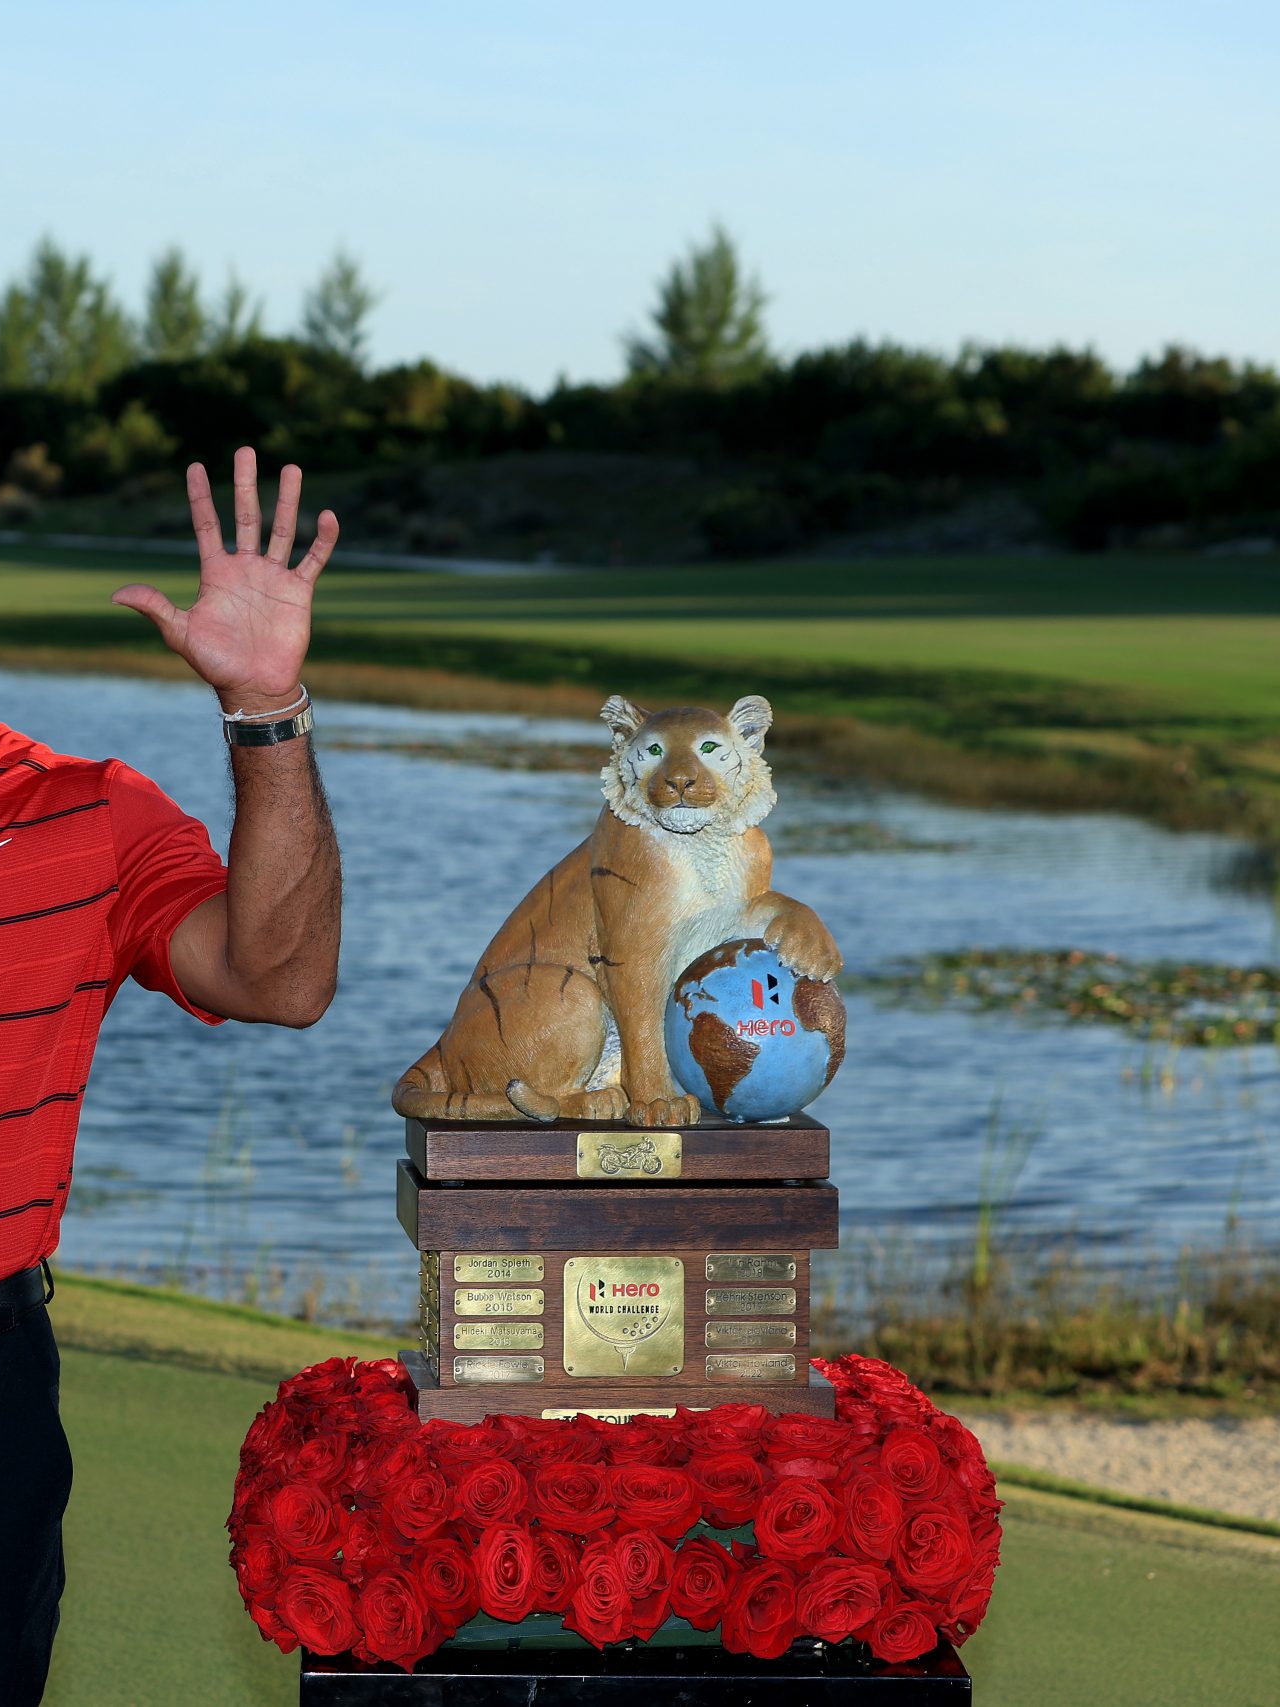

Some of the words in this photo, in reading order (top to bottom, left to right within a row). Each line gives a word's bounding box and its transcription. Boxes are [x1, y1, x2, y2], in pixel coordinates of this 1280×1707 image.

[736, 1018, 796, 1036] Hero
[468, 1258, 498, 1267] Jordan
[501, 1258, 531, 1267] Spieth
[487, 1269, 511, 1278] 2014
[612, 1283, 660, 1297] Hero
[467, 1292, 494, 1301] Bubba
[497, 1292, 532, 1301] Watson
[748, 1292, 787, 1301] Stenson
[485, 1303, 514, 1312] 2015
[589, 1305, 614, 1314] WORLD
[617, 1305, 660, 1314] CHALLENGE
[461, 1327, 487, 1335] Hideki
[490, 1327, 537, 1336] Matsuyama
[498, 1360, 530, 1369] Fowle
[716, 1359, 742, 1368] Viktor
